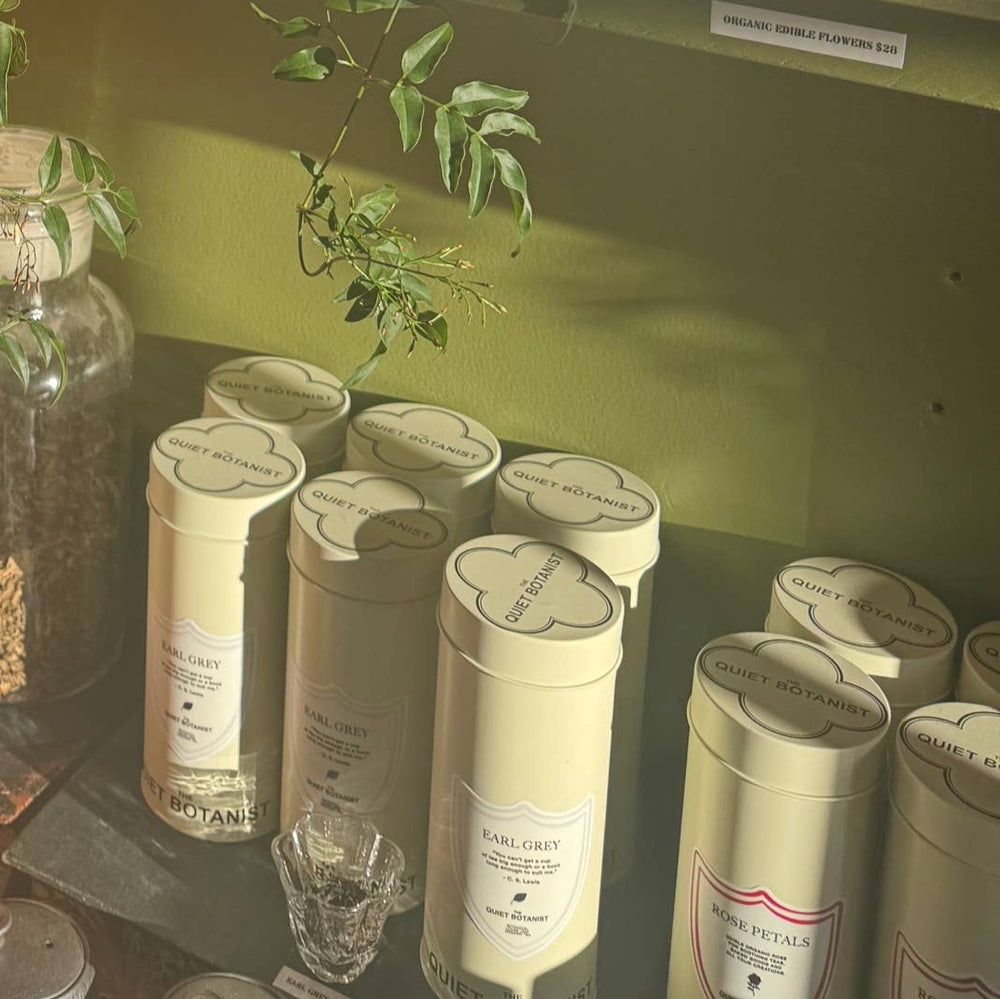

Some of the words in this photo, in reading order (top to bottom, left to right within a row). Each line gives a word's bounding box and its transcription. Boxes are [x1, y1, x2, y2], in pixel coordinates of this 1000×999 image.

[723, 14, 773, 32] ORGANIC
[775, 23, 816, 41] EDIBLE
[818, 31, 873, 51] FLOWERS
[876, 41, 898, 56] $28
[218, 380, 258, 392] QUIET
[264, 386, 332, 402] BOTANIST
[169, 438, 210, 455] QUIET
[212, 452, 283, 478] BOTANIST
[364, 420, 406, 437] QUIET
[408, 435, 479, 460] BOTANIST
[513, 470, 559, 488] QUIET
[562, 485, 640, 512] BOTANIST
[312, 490, 356, 510] QUIET
[358, 508, 432, 538] BOTANIST
[505, 594, 533, 623] QUIET
[525, 552, 564, 597] BOTANIST
[792, 577, 843, 601] QUIET
[848, 599, 936, 636] BOTANIST
[162, 640, 187, 662] EARL
[188, 655, 222, 670] GREY
[715, 660, 771, 685] QUIET
[776, 681, 870, 717] BOTANIST
[304, 704, 332, 729] EARL
[334, 722, 368, 739] GREY
[918, 733, 978, 760] QUIET
[170, 796, 270, 825] BOTANIST
[483, 828, 520, 850] EARL
[522, 840, 561, 851] GREY
[485, 906, 509, 919] QUIET
[510, 914, 549, 922] BOTANIST
[712, 901, 748, 933] ROSE
[752, 925, 811, 949] PETALS
[770, 962, 783, 970] AND
